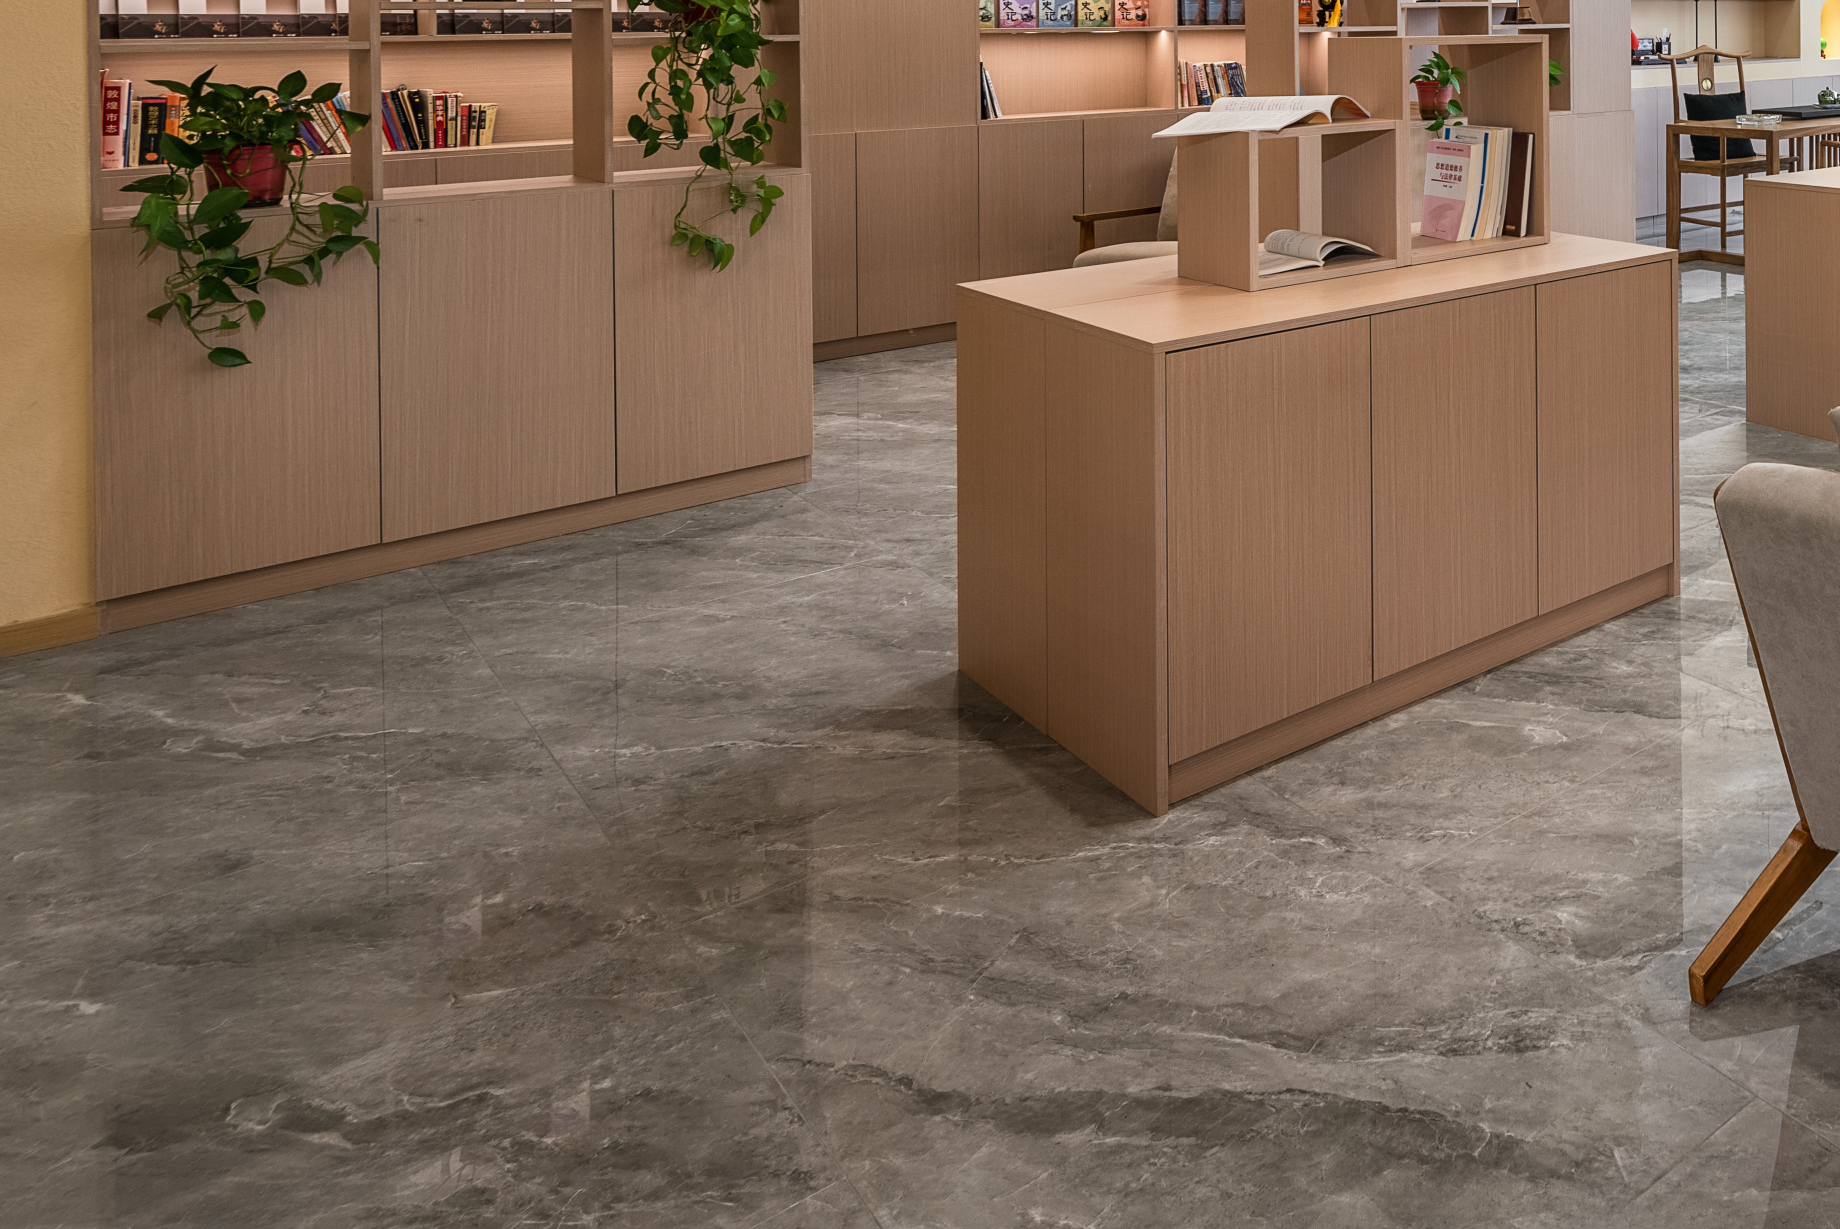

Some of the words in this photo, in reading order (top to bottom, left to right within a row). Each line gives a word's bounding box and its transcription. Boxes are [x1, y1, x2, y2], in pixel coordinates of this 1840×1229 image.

[1002, 1, 1018, 22] 史记
[1042, 1, 1057, 22] 史记
[1081, 1, 1097, 22] 史记
[1118, 1, 1133, 22] 史记
[105, 89, 119, 133] 敦煌市志
